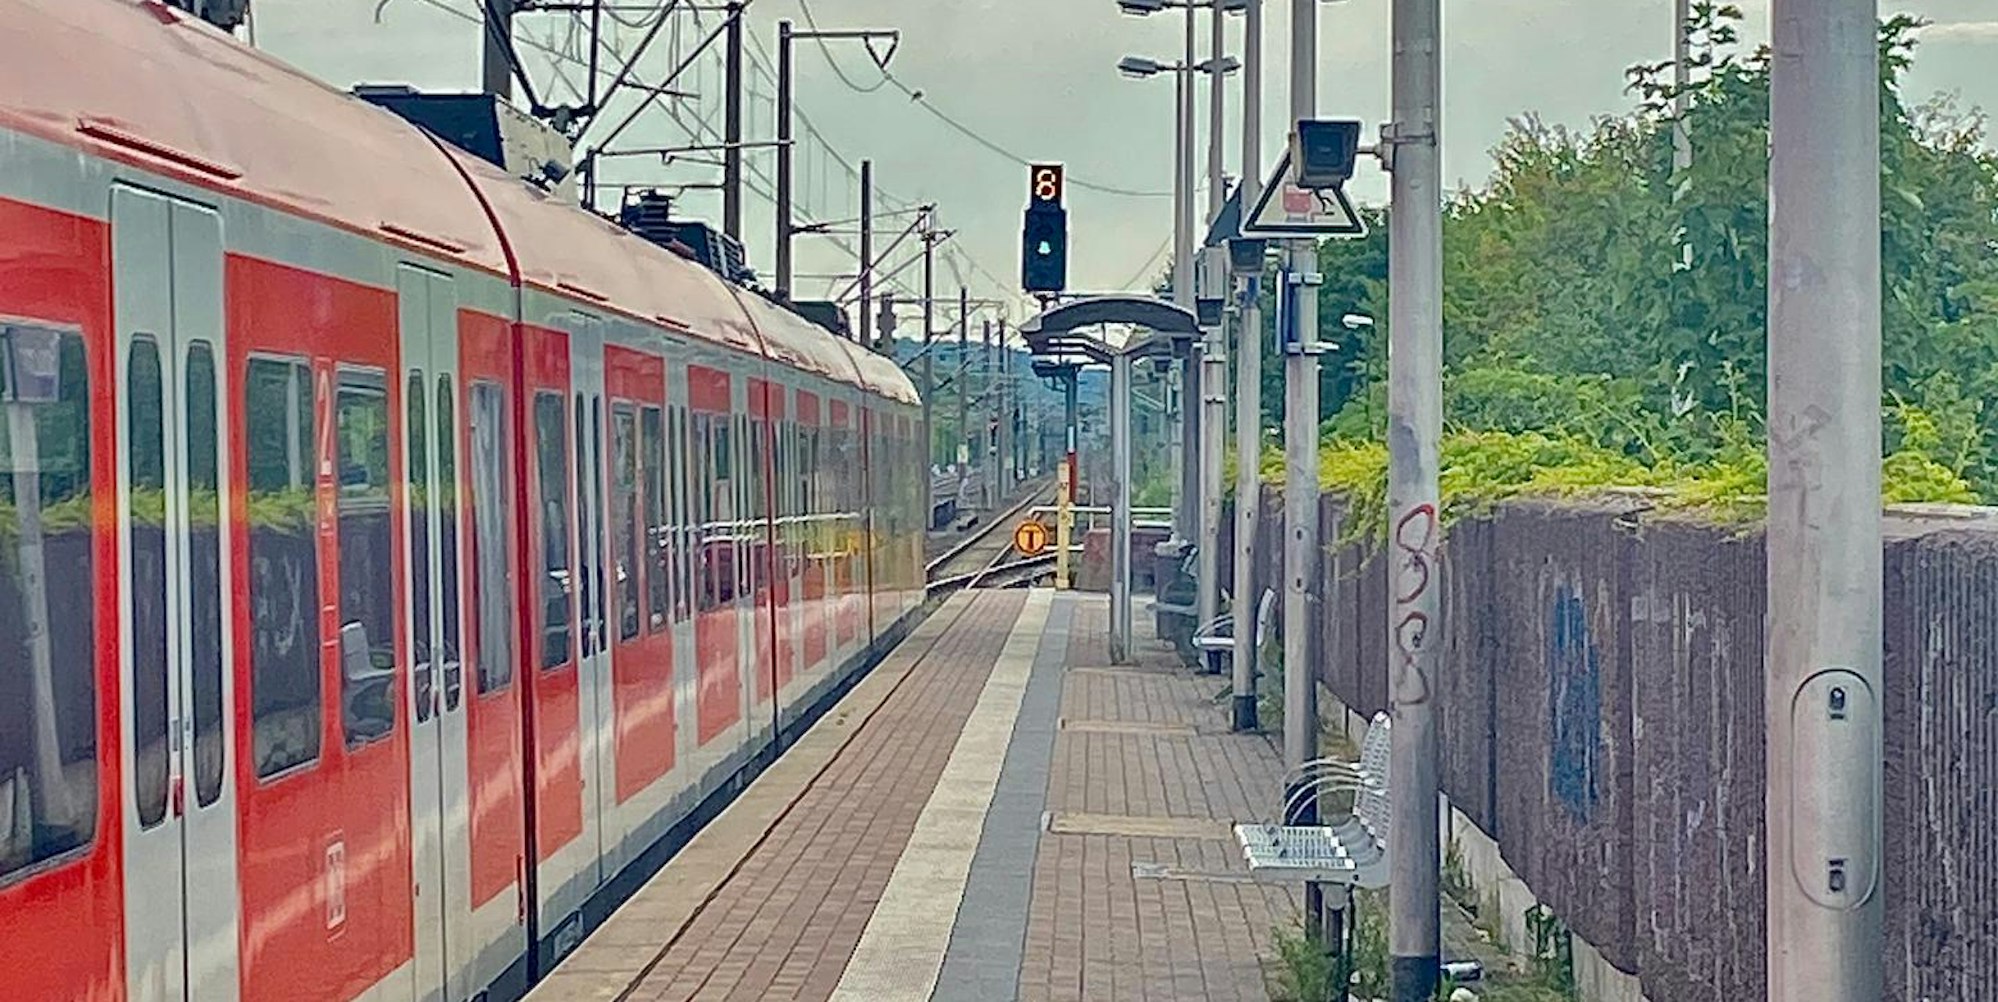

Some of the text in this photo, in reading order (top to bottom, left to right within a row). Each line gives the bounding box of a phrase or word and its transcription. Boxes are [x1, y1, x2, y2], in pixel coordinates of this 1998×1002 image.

[1035, 168, 1056, 201] 8
[317, 368, 332, 476] 2
[1020, 528, 1041, 551] T
